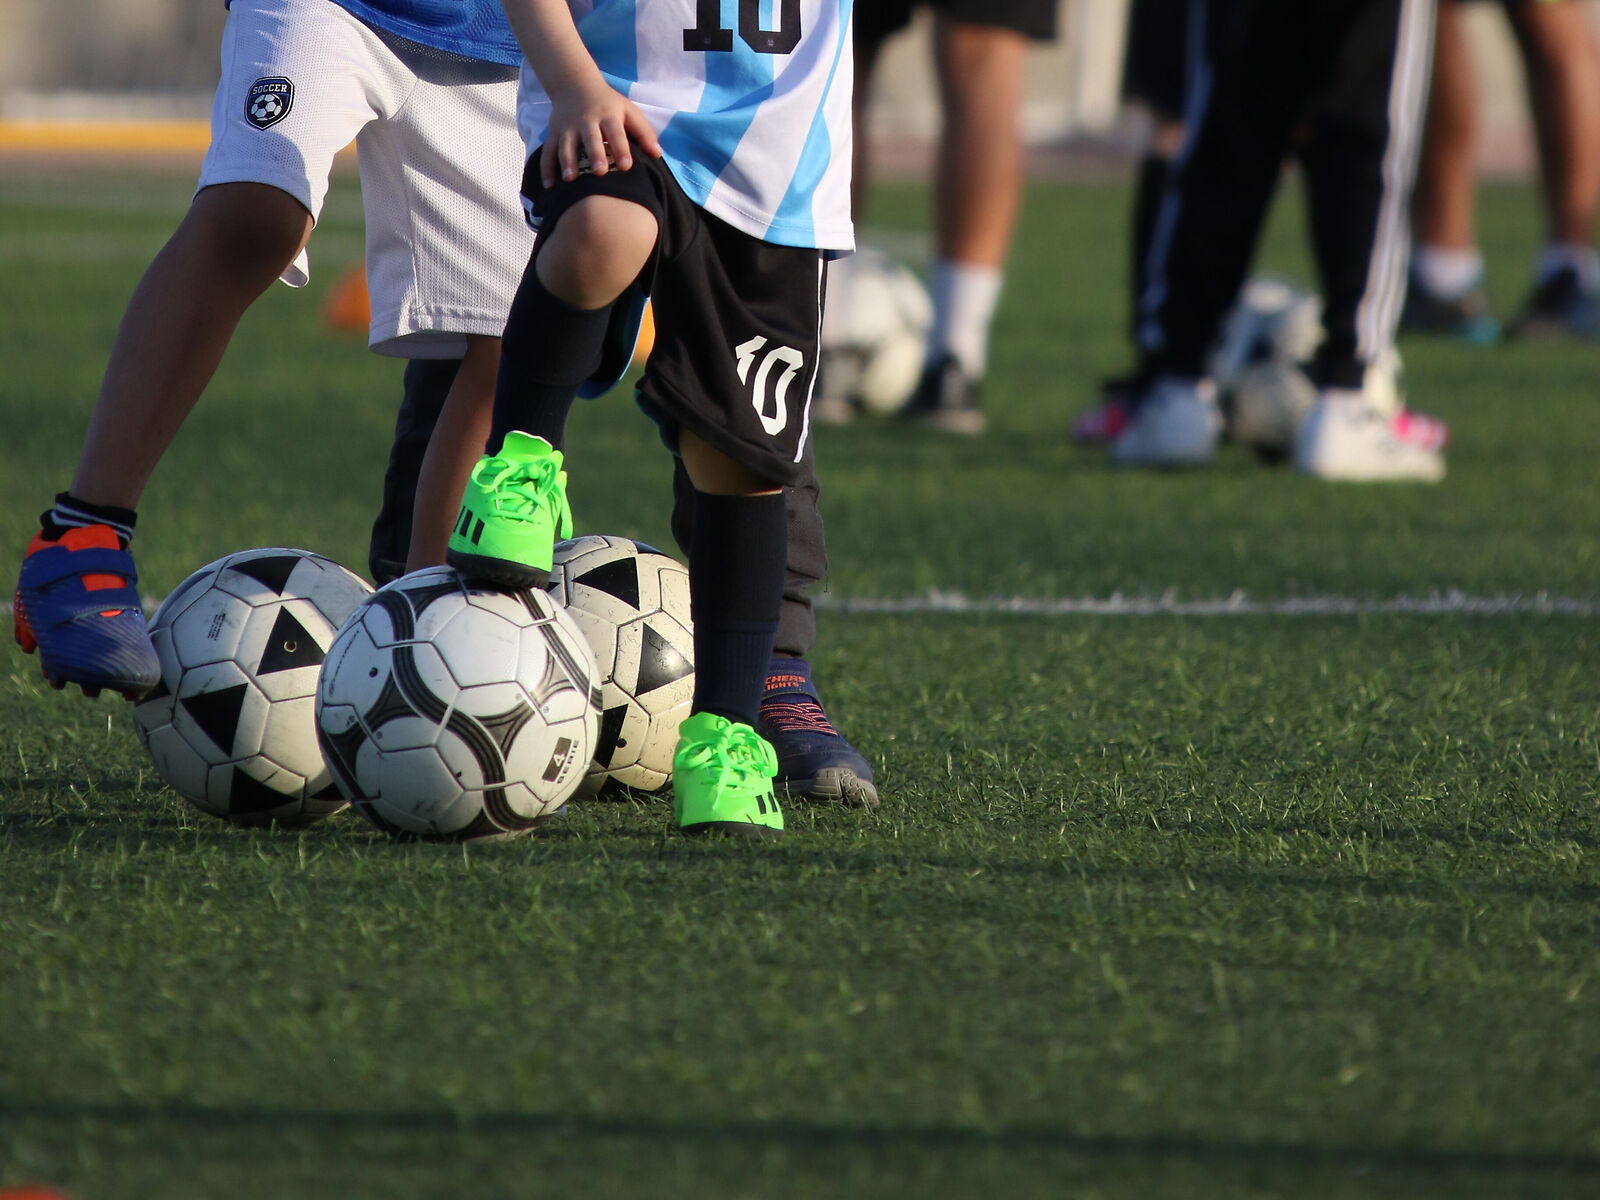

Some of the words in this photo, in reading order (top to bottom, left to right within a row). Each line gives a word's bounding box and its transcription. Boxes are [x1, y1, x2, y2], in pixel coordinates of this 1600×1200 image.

[252, 83, 288, 95] SOCCER
[735, 335, 804, 436] 10
[763, 681, 799, 692] IGHTS
